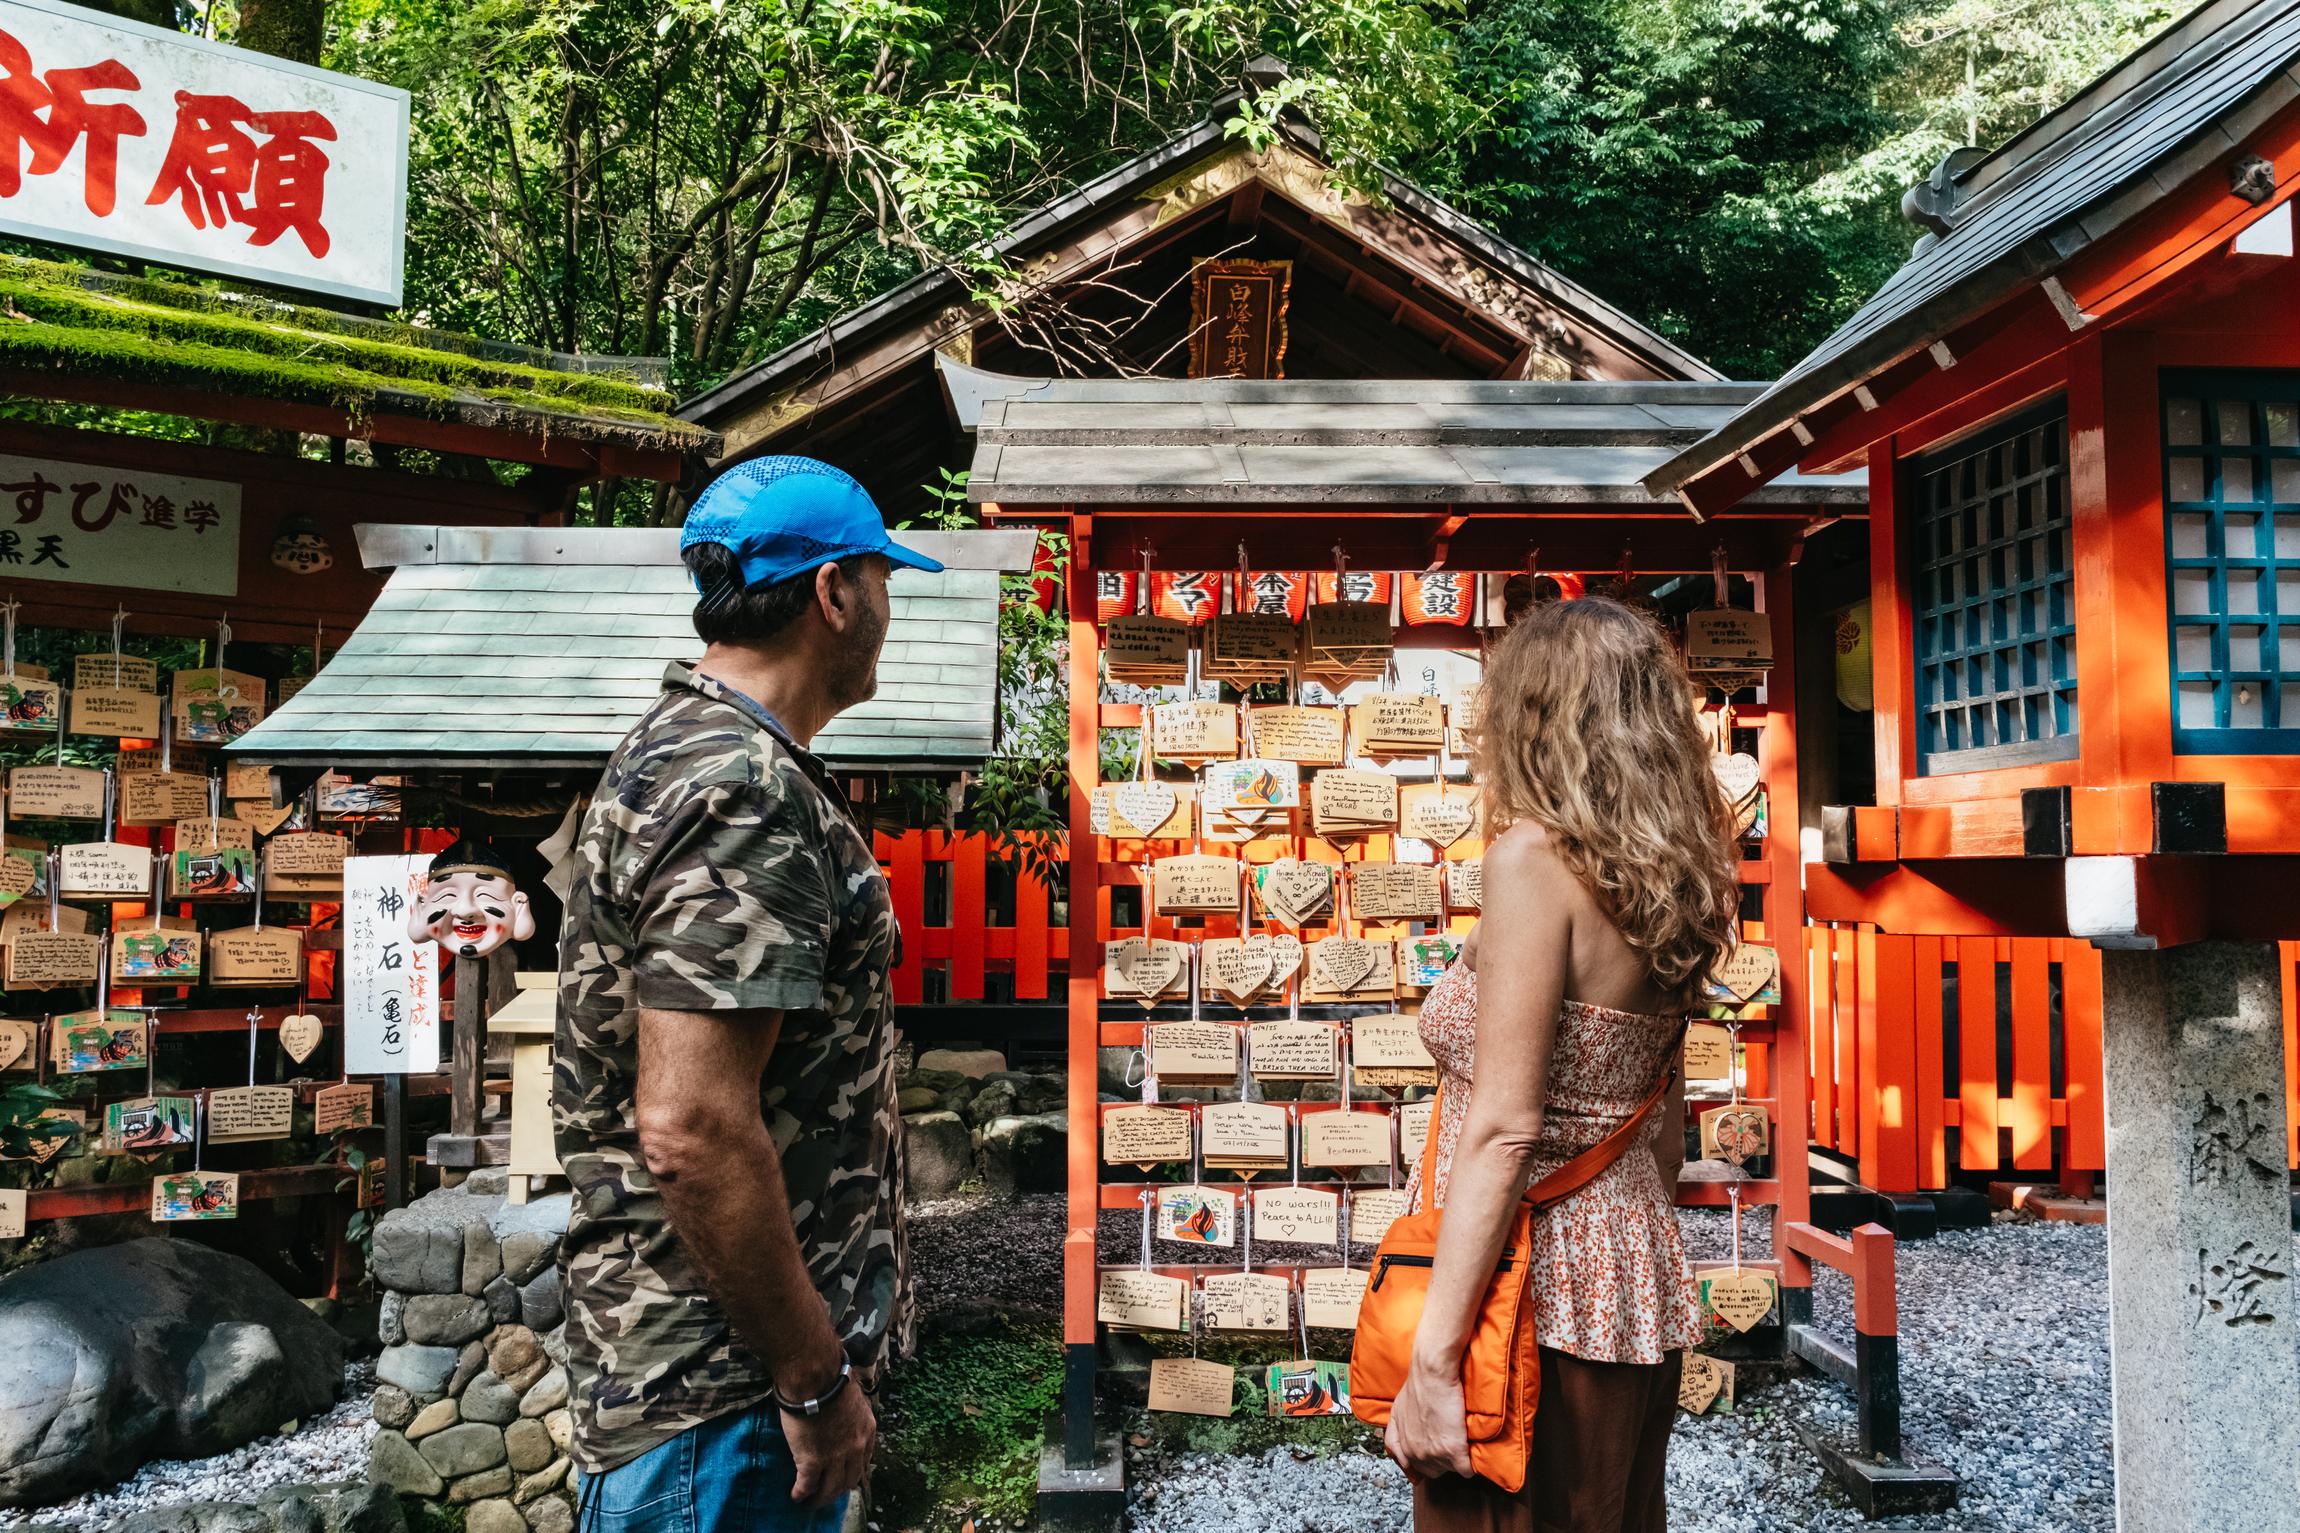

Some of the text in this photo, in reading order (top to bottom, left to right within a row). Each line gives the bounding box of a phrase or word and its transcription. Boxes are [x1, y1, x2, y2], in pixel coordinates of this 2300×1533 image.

[1424, 573, 1462, 615] 建設
[1265, 1200, 1282, 1208] NO
[1261, 1211, 1291, 1221] Peace
[1296, 1214, 1304, 1222] to
